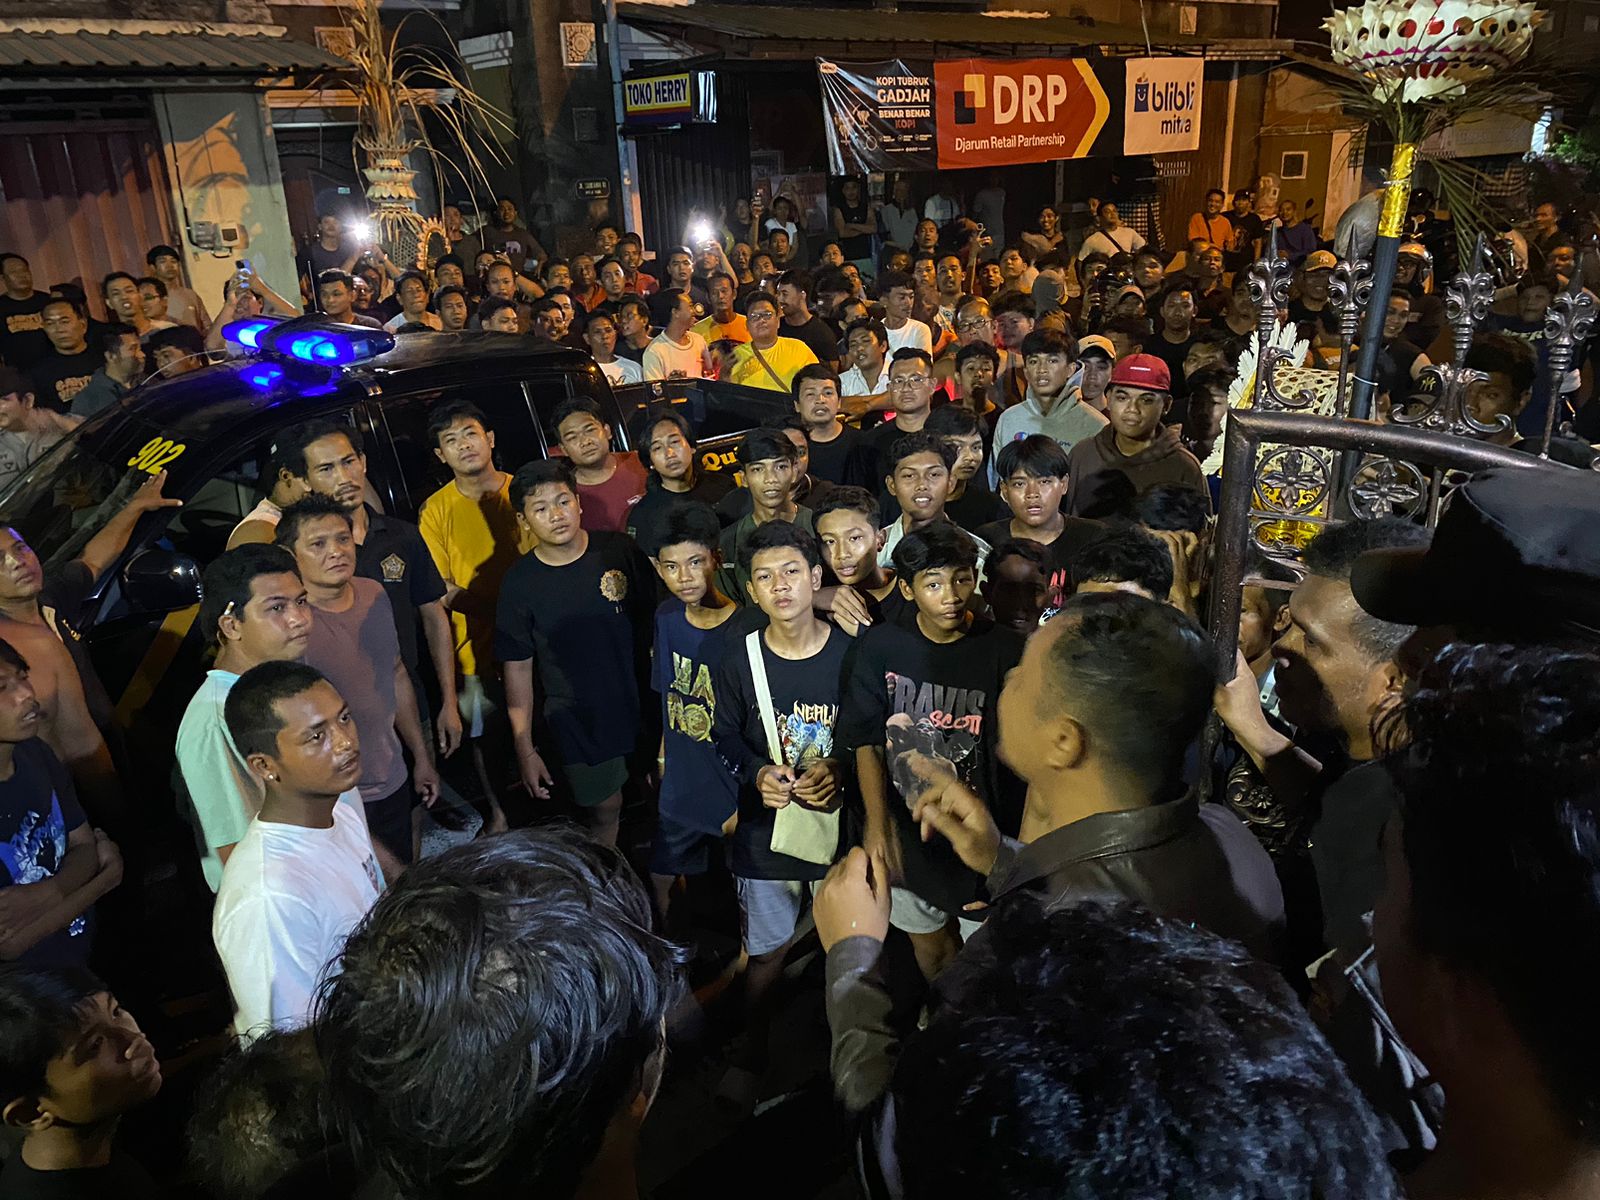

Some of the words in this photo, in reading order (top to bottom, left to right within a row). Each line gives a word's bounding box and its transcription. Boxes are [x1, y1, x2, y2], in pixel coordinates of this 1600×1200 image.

[876, 76, 896, 86] KOPI
[897, 76, 930, 86] TUBRUK
[627, 83, 652, 106] TOKO
[654, 78, 688, 103] HERRY
[877, 88, 930, 103] GADJAH
[993, 74, 1067, 124] DRP
[1152, 82, 1195, 112] blibli
[879, 110, 904, 118] BENAR
[905, 109, 931, 118] BENAR
[895, 119, 916, 128] KOPI
[955, 137, 989, 153] Djarum
[990, 134, 1016, 149] Retail
[1017, 132, 1066, 147] Partnership
[701, 446, 738, 472] Qu
